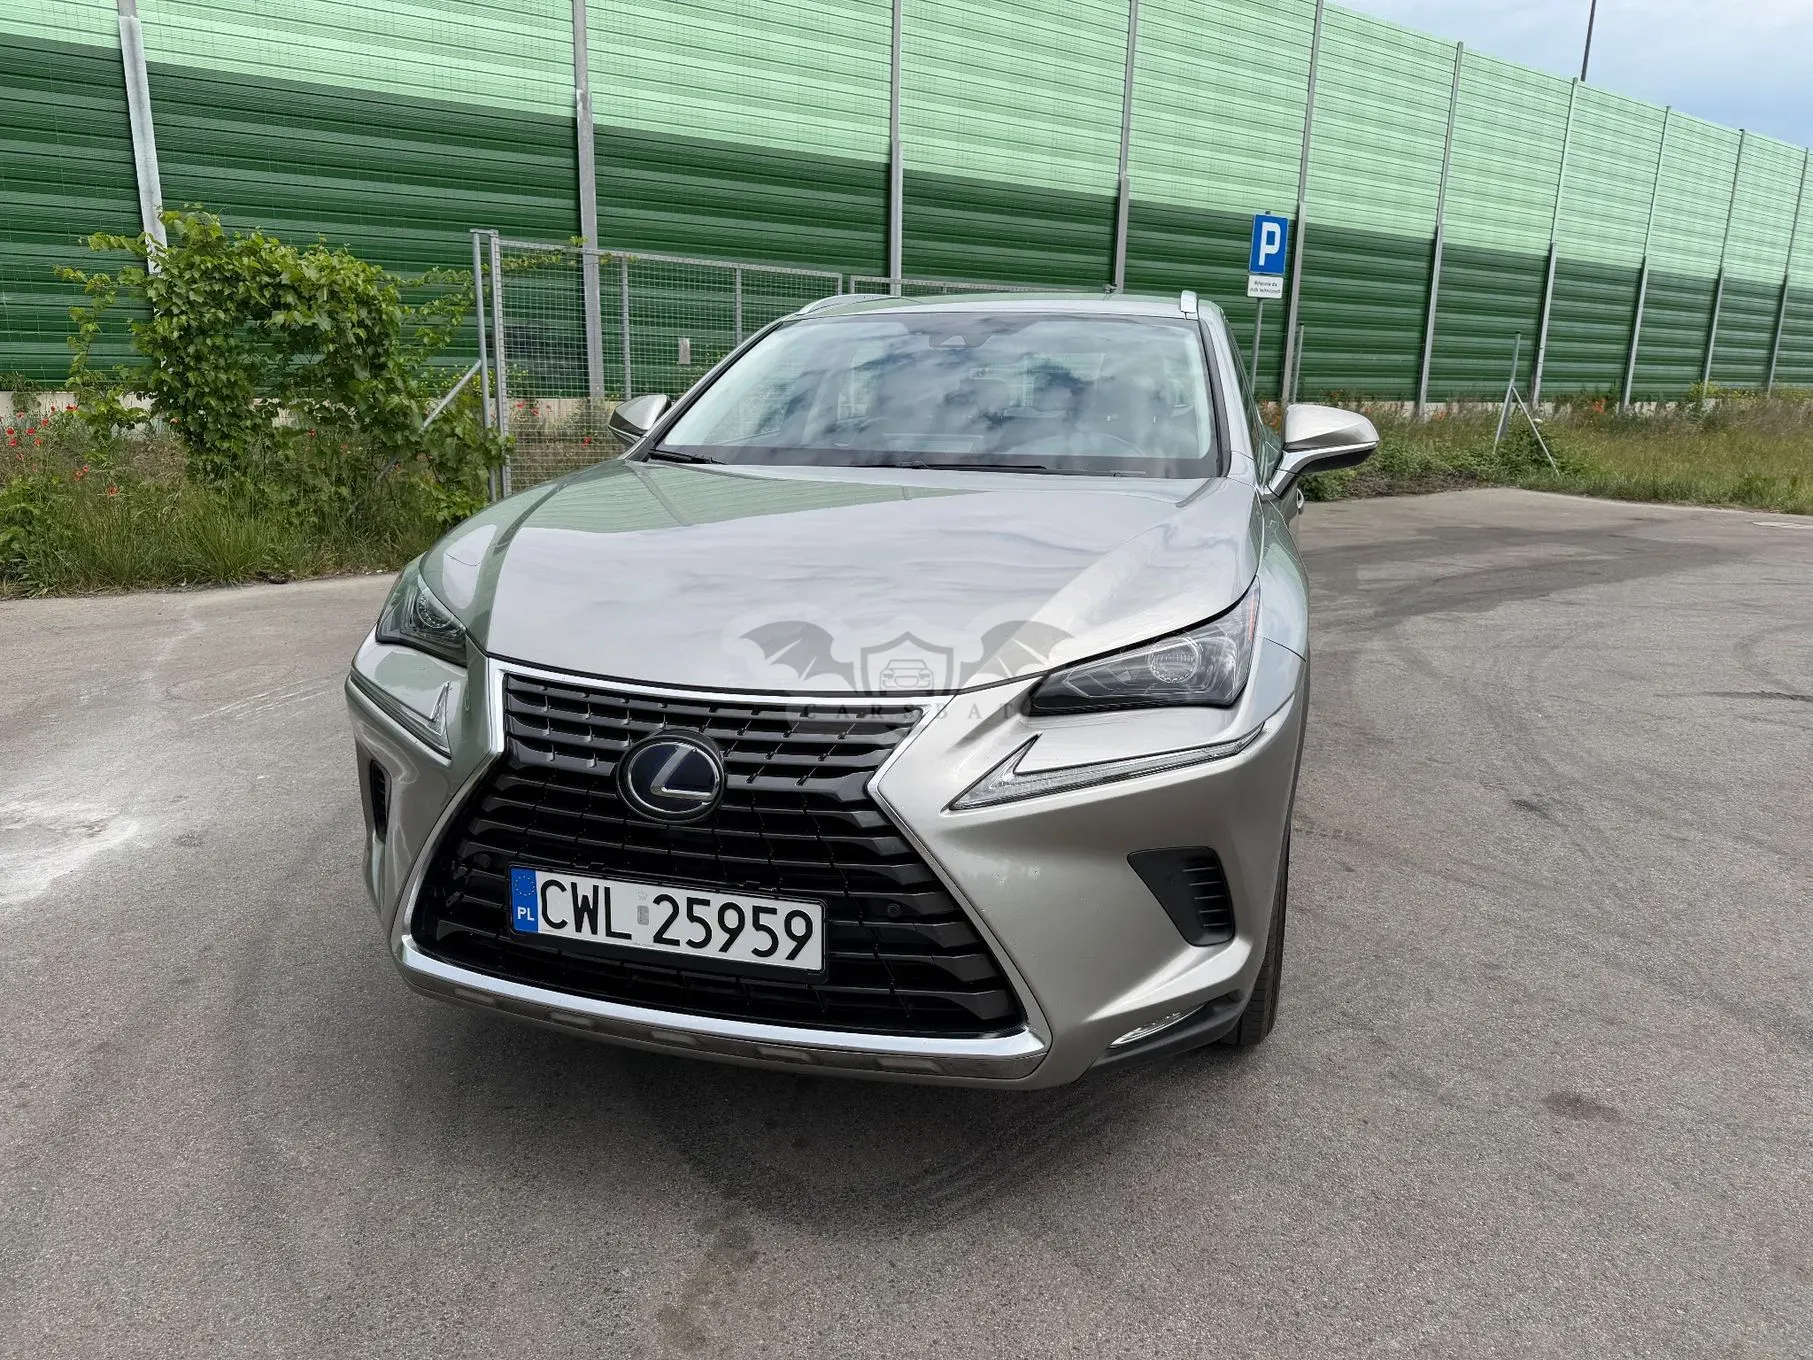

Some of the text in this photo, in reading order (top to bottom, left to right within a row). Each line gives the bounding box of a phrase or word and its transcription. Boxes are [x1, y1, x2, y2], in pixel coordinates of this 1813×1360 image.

[1259, 221, 1281, 266] P
[517, 906, 535, 921] PL
[540, 879, 813, 960] CWL 25959
